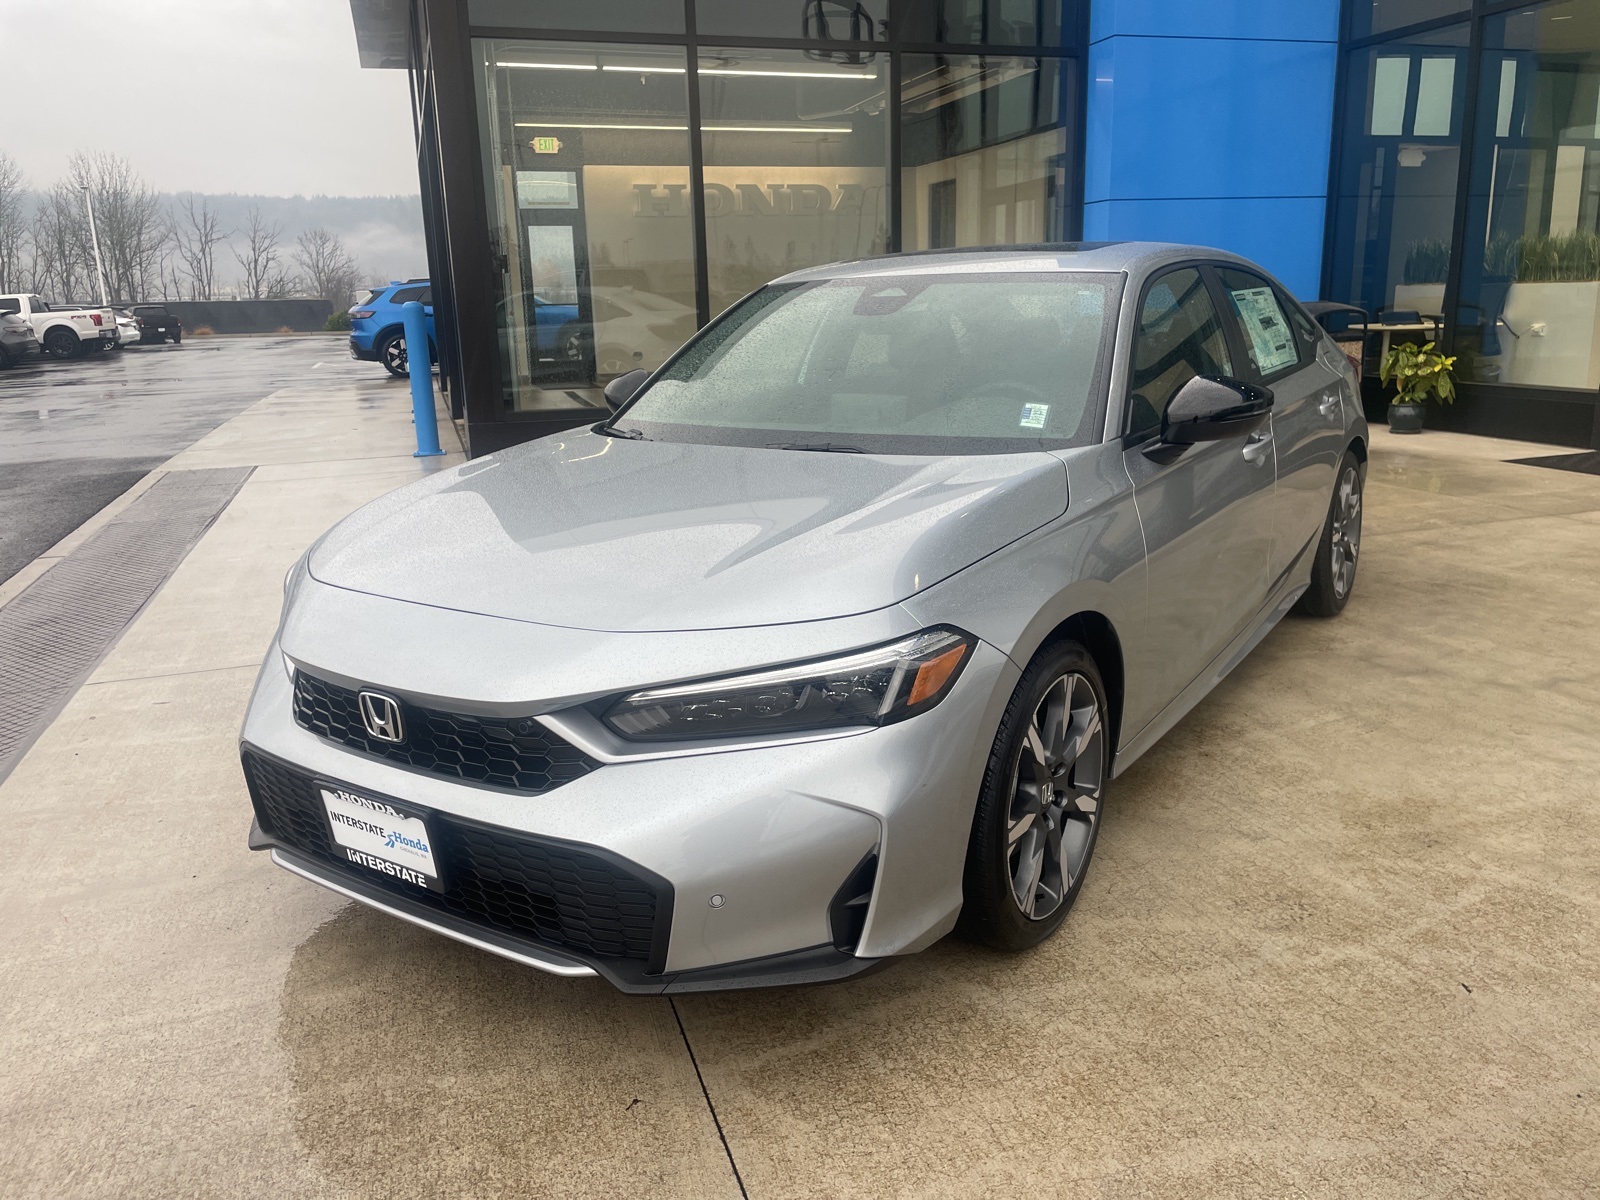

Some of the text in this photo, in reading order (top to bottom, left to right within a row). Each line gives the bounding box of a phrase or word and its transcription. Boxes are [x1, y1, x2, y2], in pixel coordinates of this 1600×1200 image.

[538, 138, 554, 151] EXIT
[632, 183, 875, 216] HONDA
[337, 790, 399, 817] HONDA
[330, 810, 386, 838] INTERSTATE
[393, 831, 429, 853] Honda
[346, 848, 428, 888] INTERSTATE
